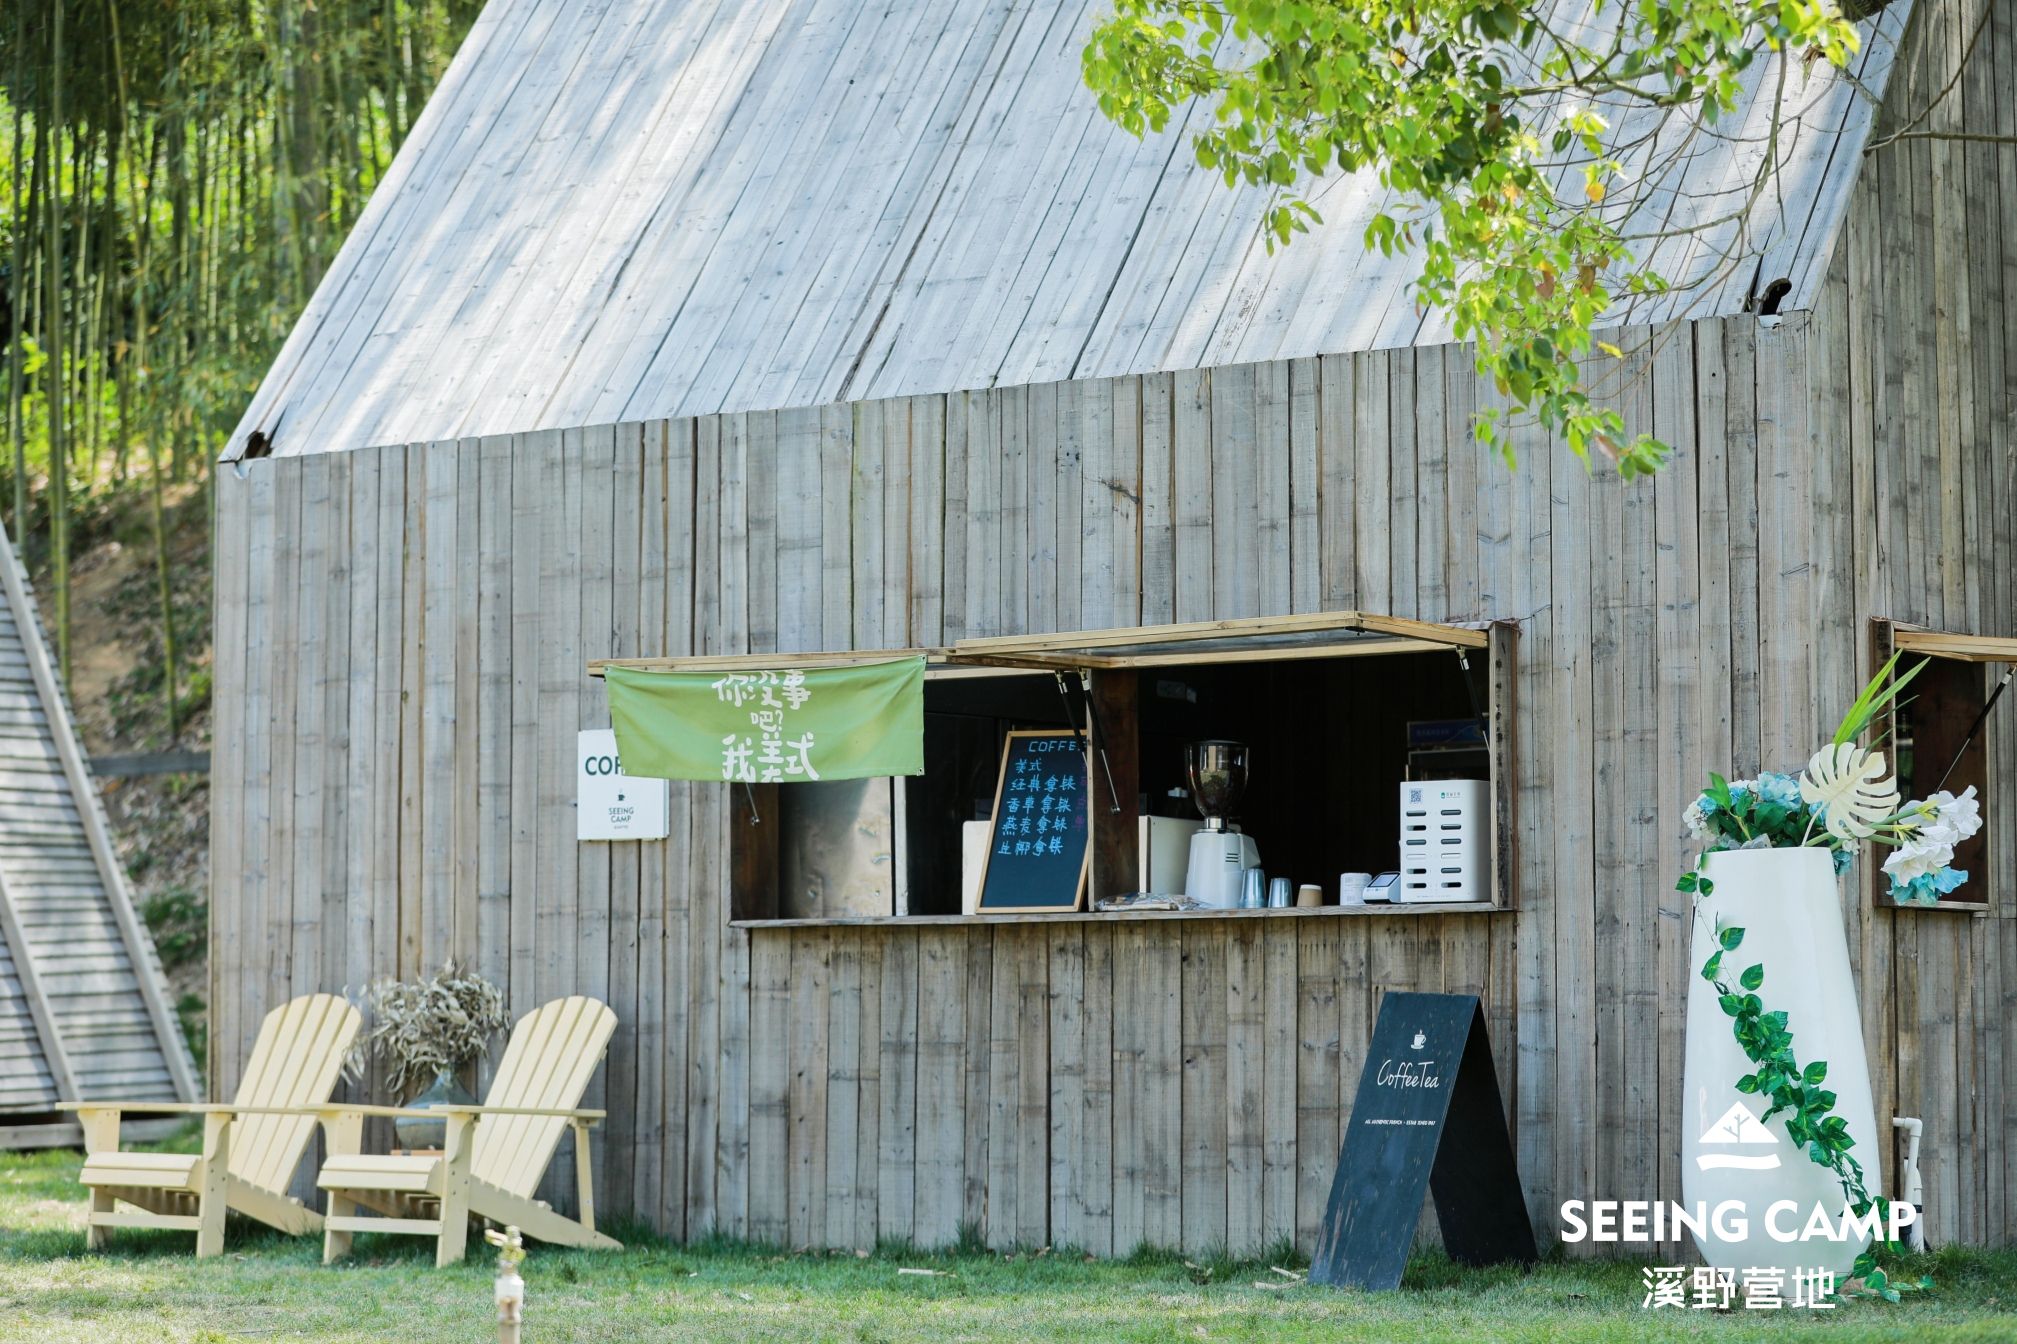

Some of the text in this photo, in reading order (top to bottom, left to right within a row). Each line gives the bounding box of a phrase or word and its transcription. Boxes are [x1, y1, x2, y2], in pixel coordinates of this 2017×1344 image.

[712, 669, 811, 710] 你没事
[722, 732, 820, 783] 我美式
[1015, 758, 1042, 774] 美式
[1010, 774, 1076, 793] 经典拿铁
[608, 807, 634, 815] SEEING
[1006, 794, 1072, 814] 香草拿铁
[611, 815, 631, 823] CAMP
